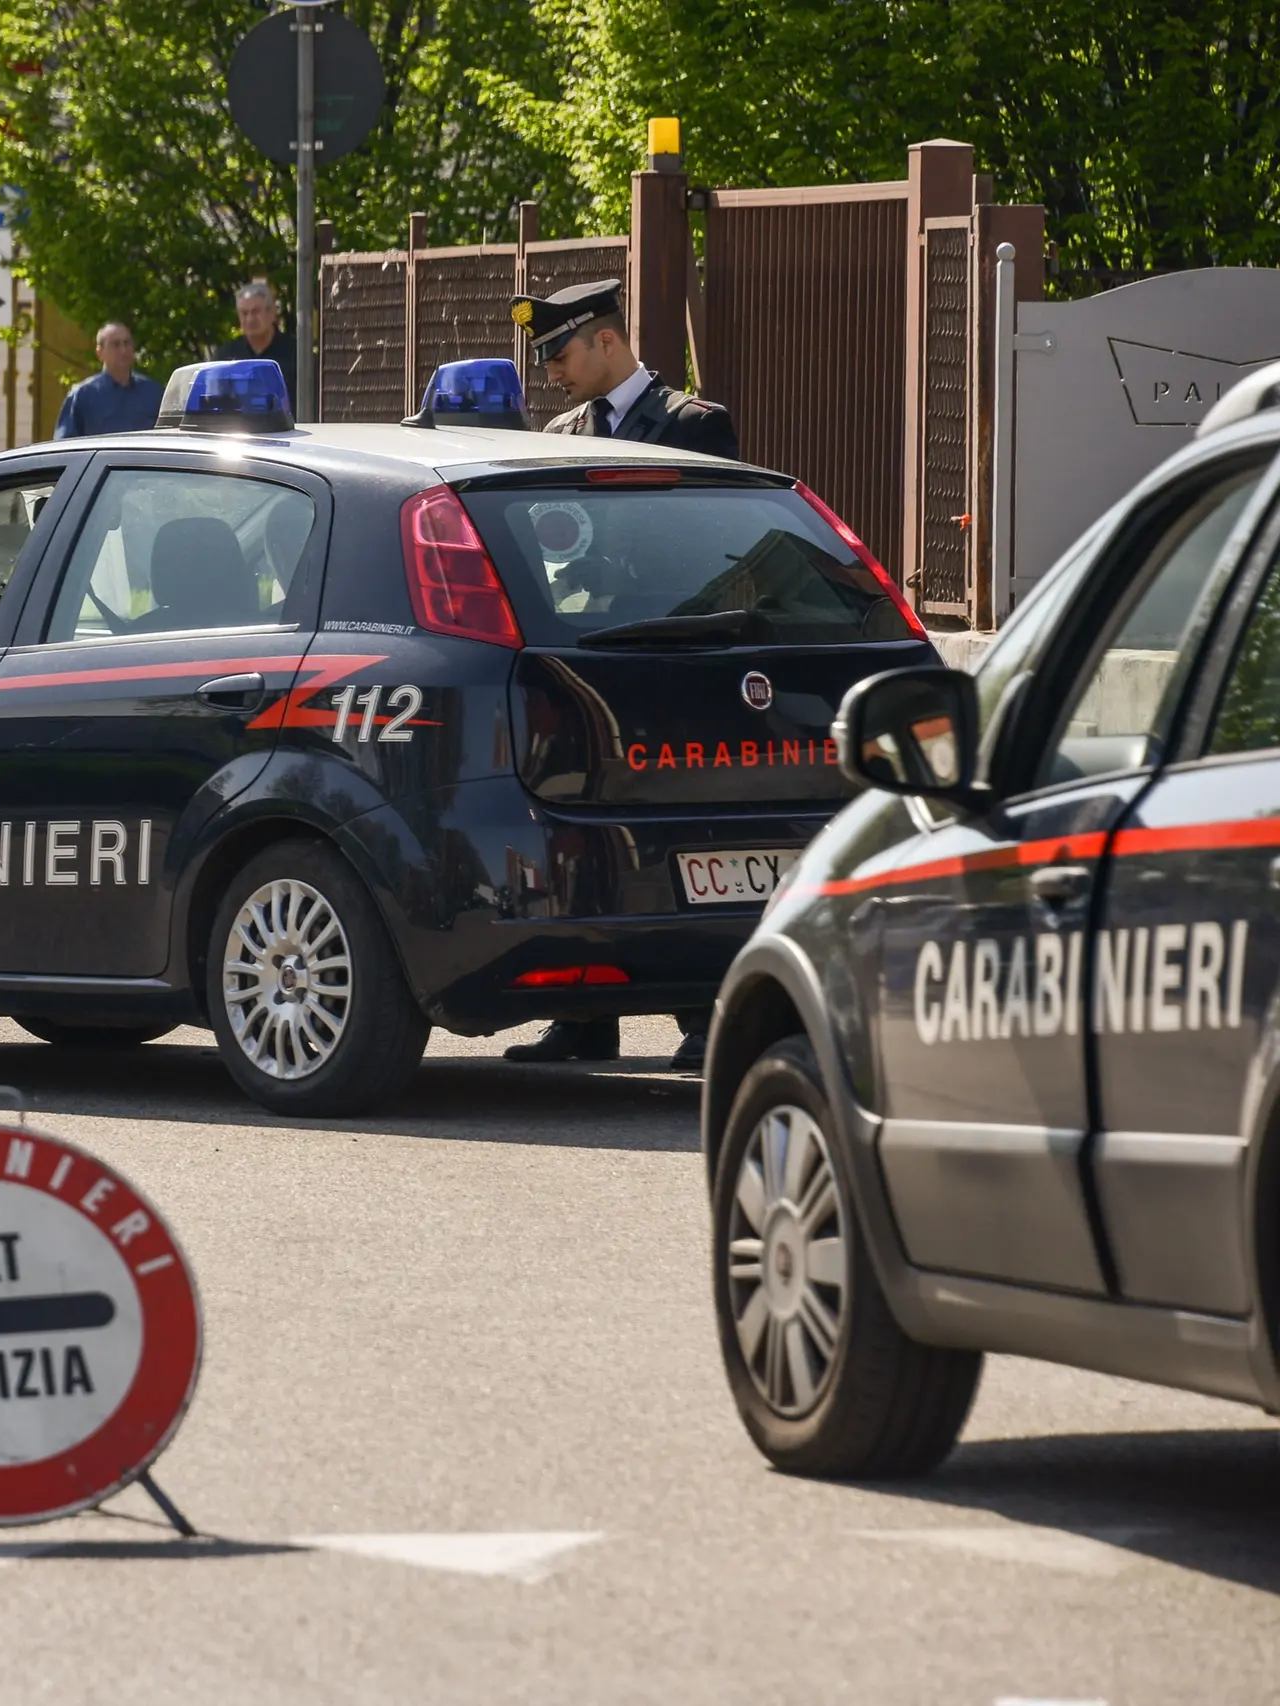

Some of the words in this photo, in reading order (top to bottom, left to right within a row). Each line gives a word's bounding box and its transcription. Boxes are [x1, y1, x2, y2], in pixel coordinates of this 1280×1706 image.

[323, 620, 416, 635] WWW.CARABINIERI.IT
[749, 682, 767, 700] FIAT
[331, 684, 423, 743] 112
[627, 738, 839, 771] CARABINIE
[687, 858, 729, 896] CC
[914, 919, 1249, 1045] CARABINIERI
